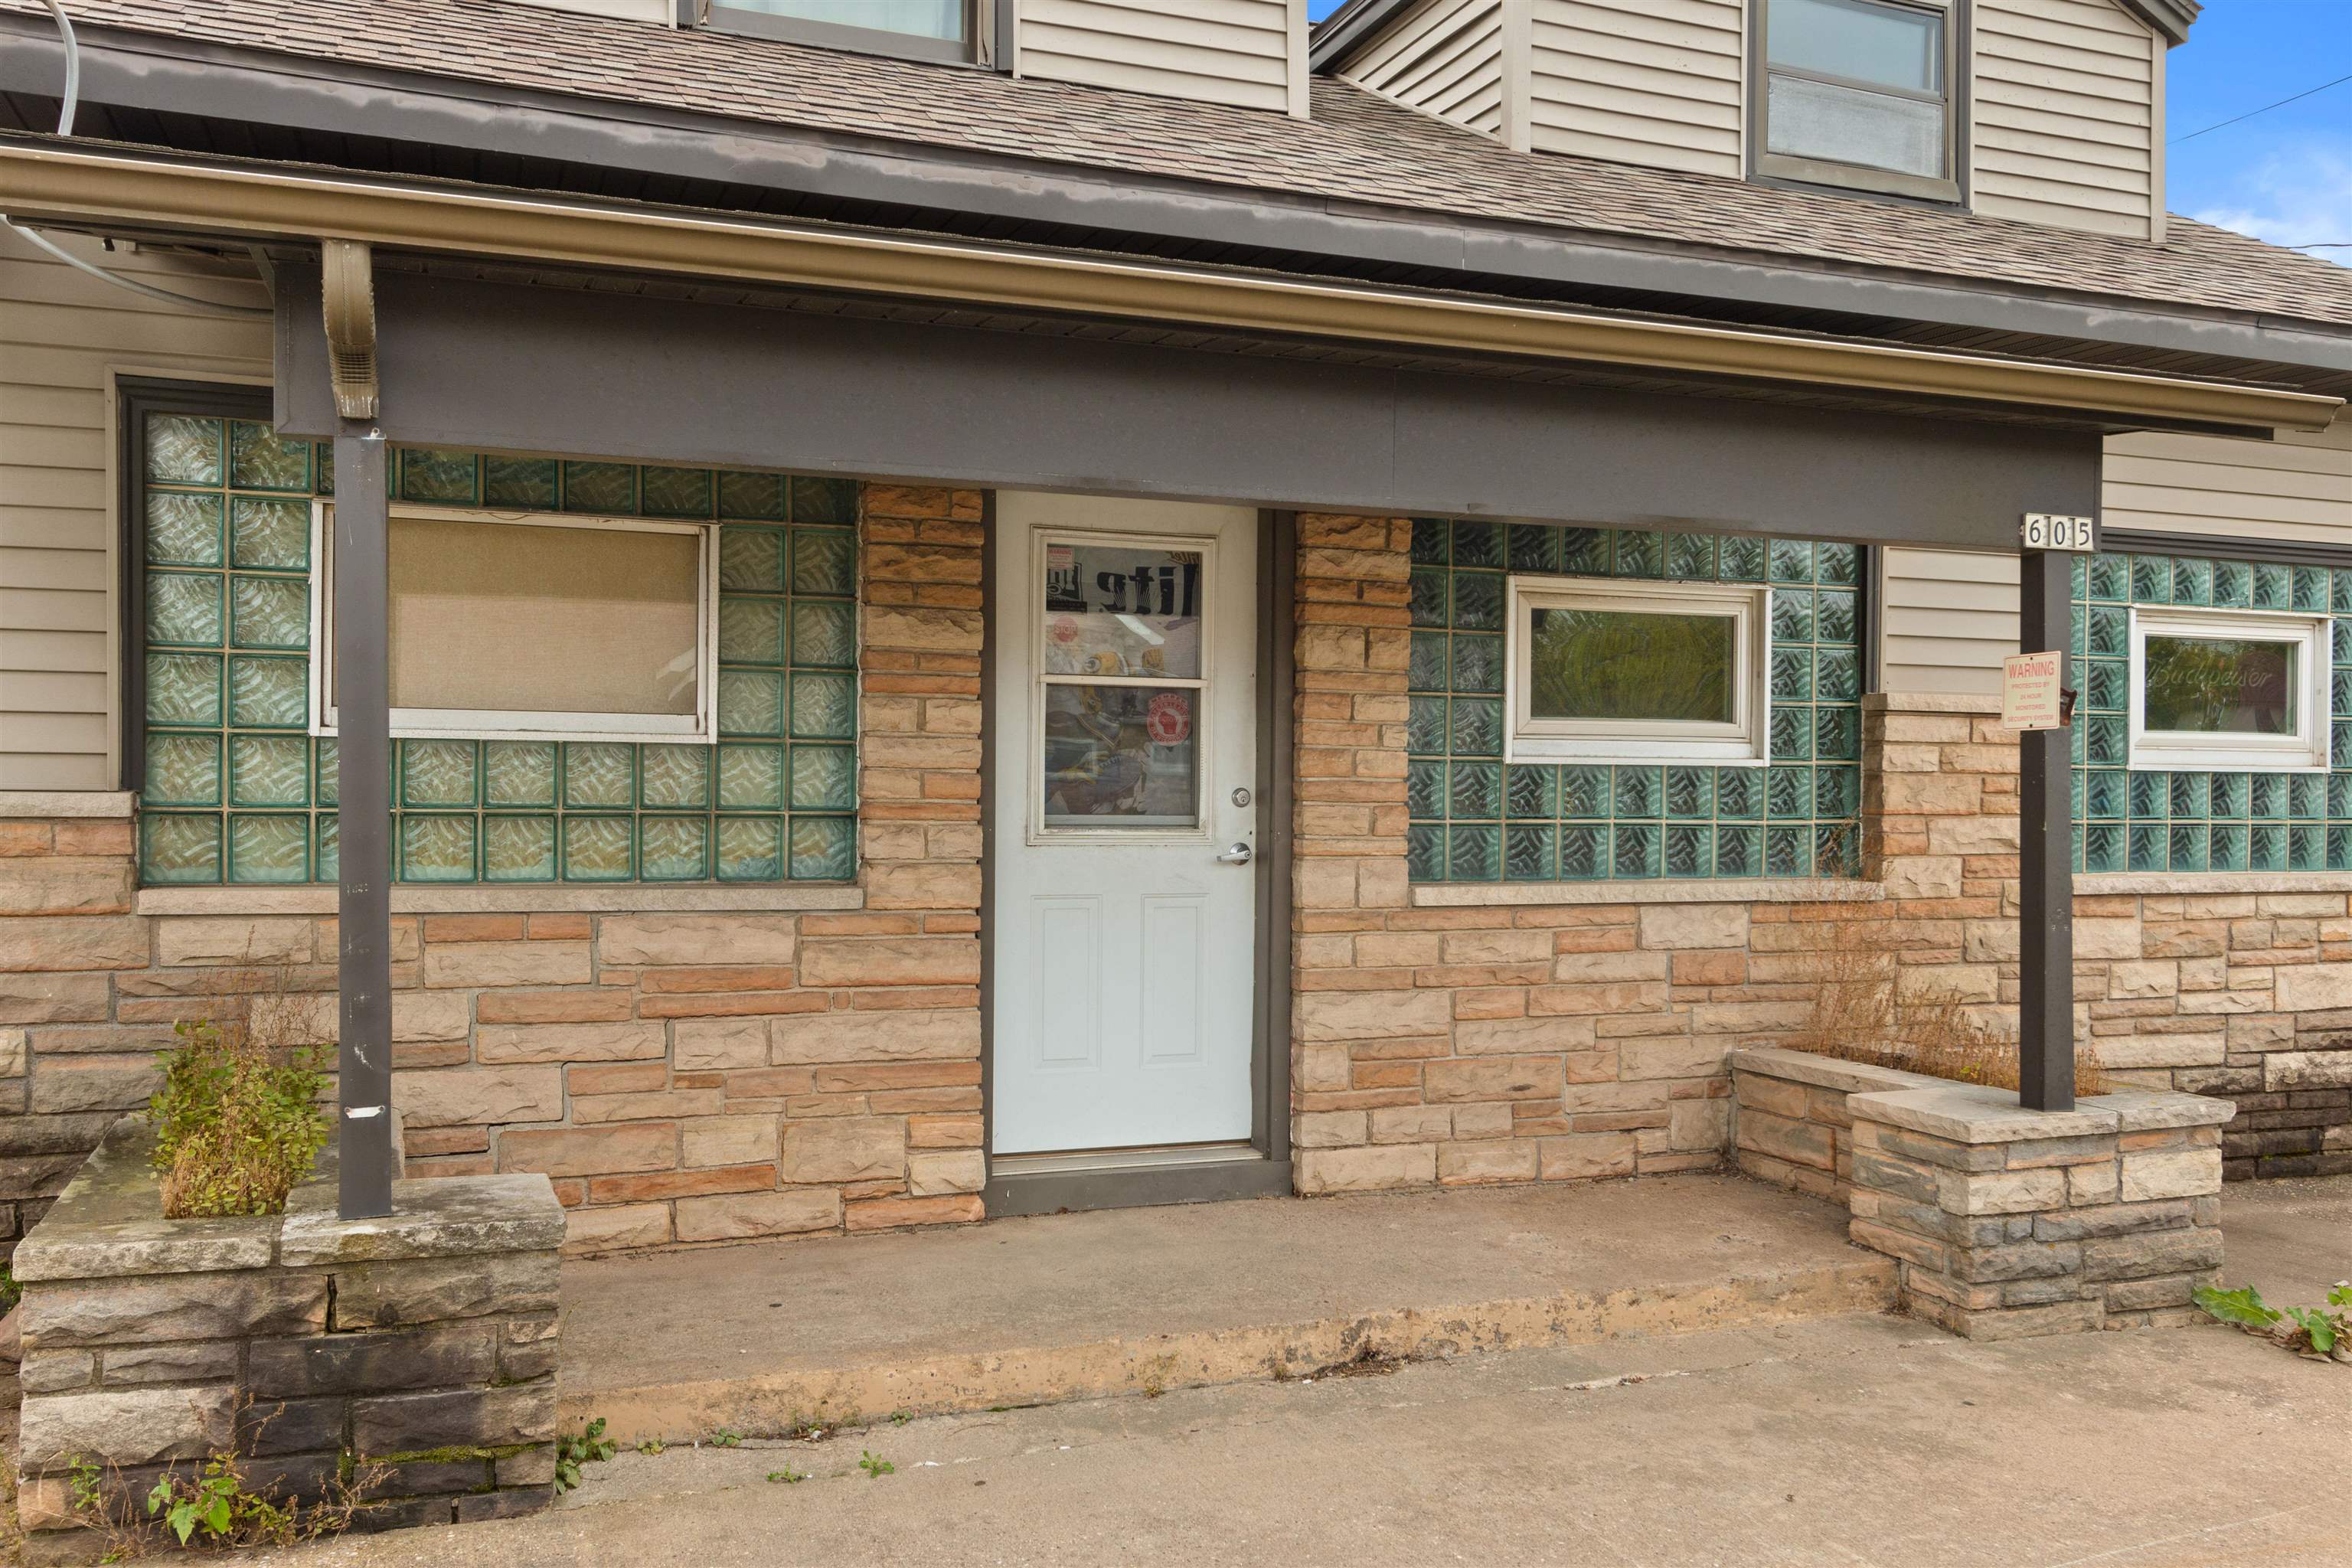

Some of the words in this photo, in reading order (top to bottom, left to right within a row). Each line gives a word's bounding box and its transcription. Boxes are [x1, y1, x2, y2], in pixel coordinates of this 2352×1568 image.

[2029, 519, 2089, 546] 605
[1054, 625, 1078, 635] STOP
[2008, 661, 2055, 678] WARNING
